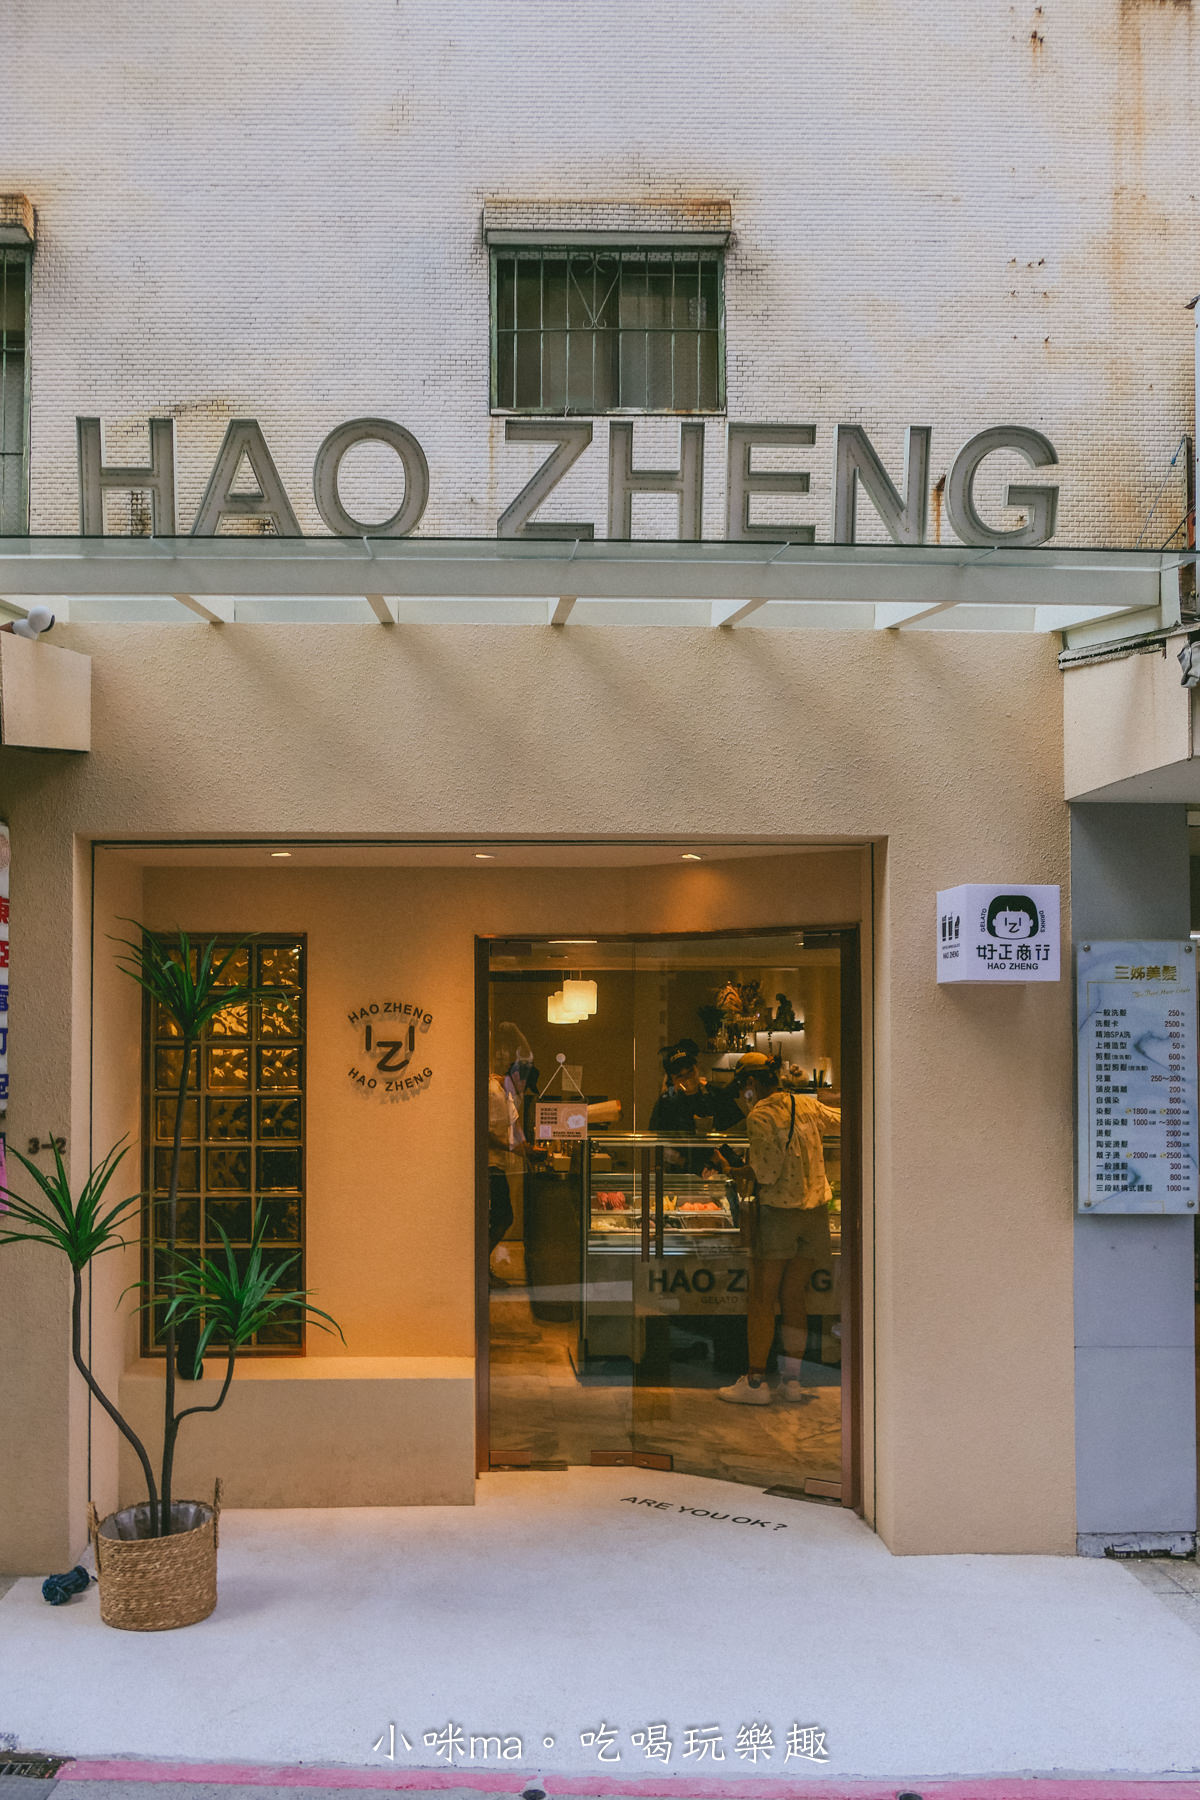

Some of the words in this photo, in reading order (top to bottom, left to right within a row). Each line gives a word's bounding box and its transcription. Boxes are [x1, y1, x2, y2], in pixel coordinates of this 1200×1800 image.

[76, 417, 429, 538] HAO
[497, 420, 1059, 547] ZHENG
[976, 944, 1050, 960] 好正商行
[348, 1003, 379, 1024] HAO
[384, 1002, 433, 1024] ZHENG
[1168, 1009, 1180, 1017] 250
[1165, 1020, 1180, 1028] 2500
[1169, 1031, 1180, 1039] 400
[1172, 1042, 1180, 1050] 50
[348, 1067, 377, 1089] HAO
[385, 1067, 433, 1091] ZHENG
[28, 1137, 67, 1155] 3-2
[649, 1268, 716, 1293] HAO
[620, 1496, 673, 1510] ARE
[678, 1506, 730, 1520] YOU
